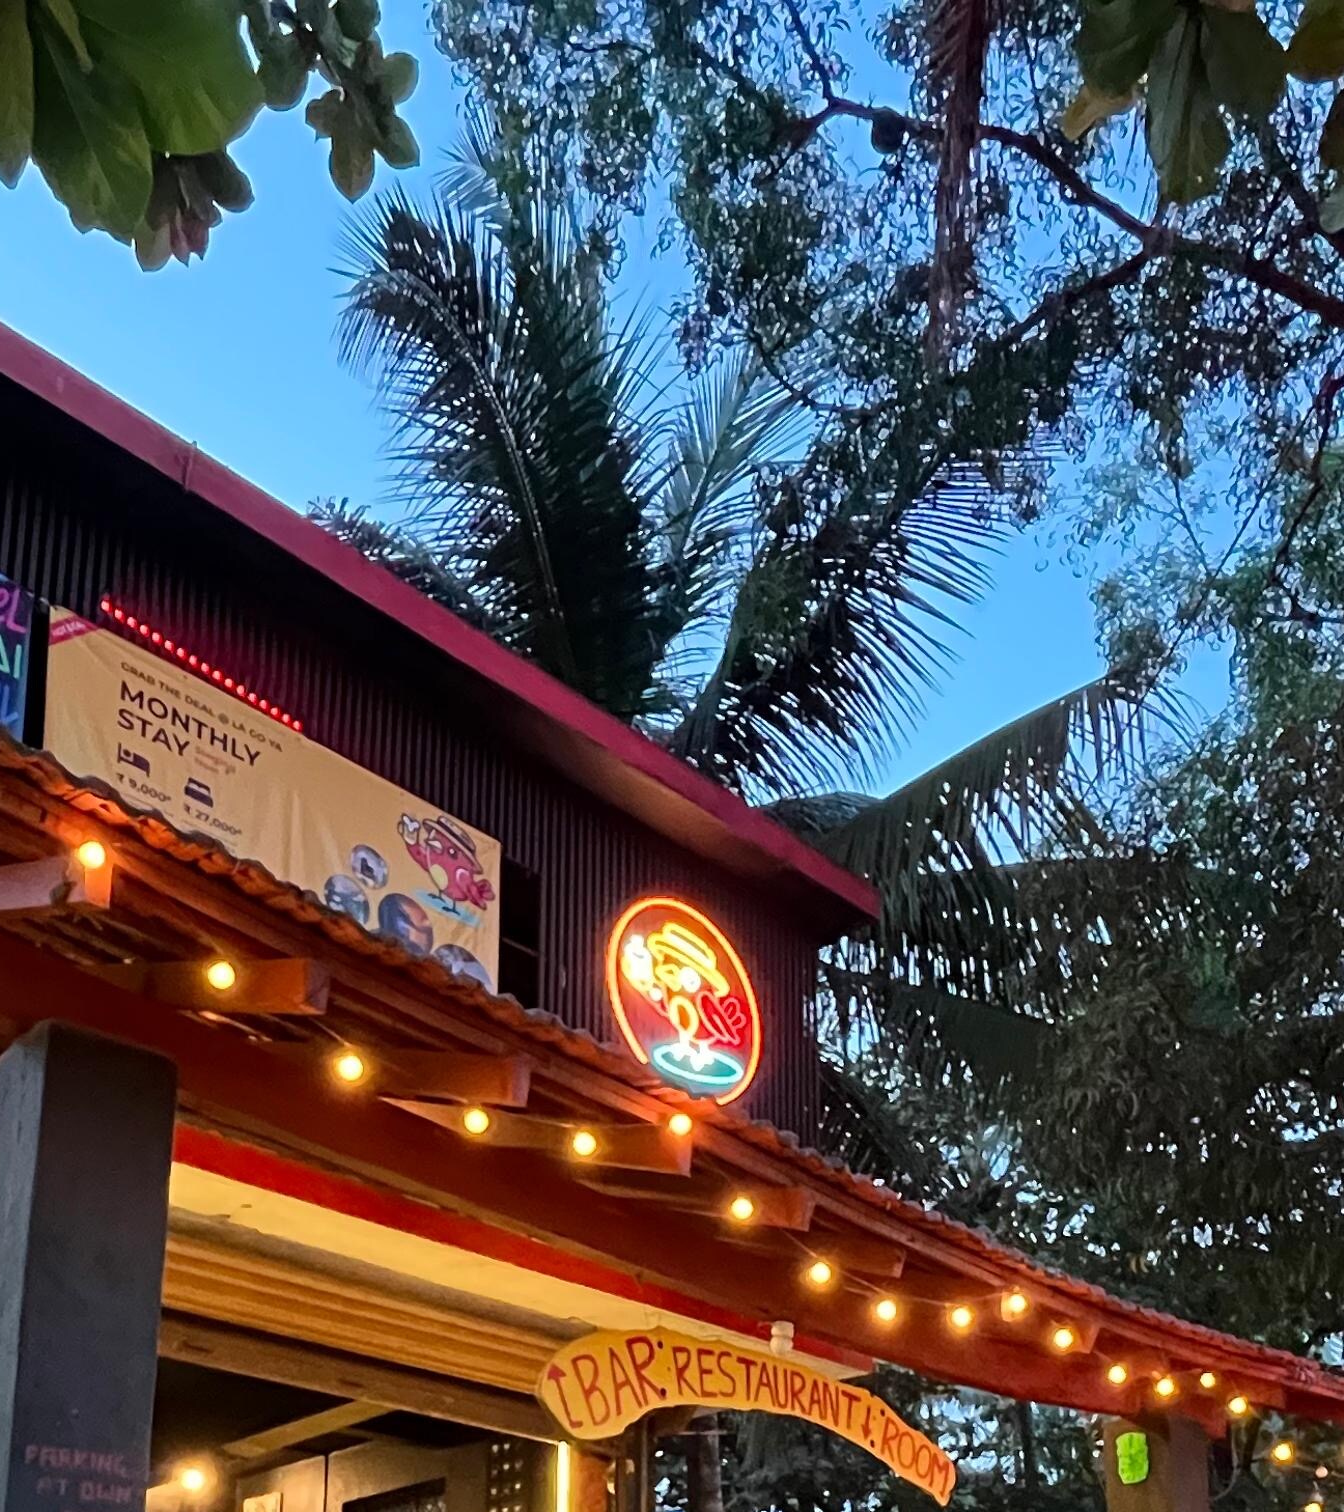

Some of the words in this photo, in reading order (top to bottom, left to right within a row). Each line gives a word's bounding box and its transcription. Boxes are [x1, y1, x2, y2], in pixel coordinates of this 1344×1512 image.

[120, 680, 261, 766] MONTHLY
[158, 680, 182, 700] THE
[117, 708, 190, 757] STAY
[672, 1346, 863, 1430] RESTAURANT
[881, 1420, 951, 1498] ROOM
